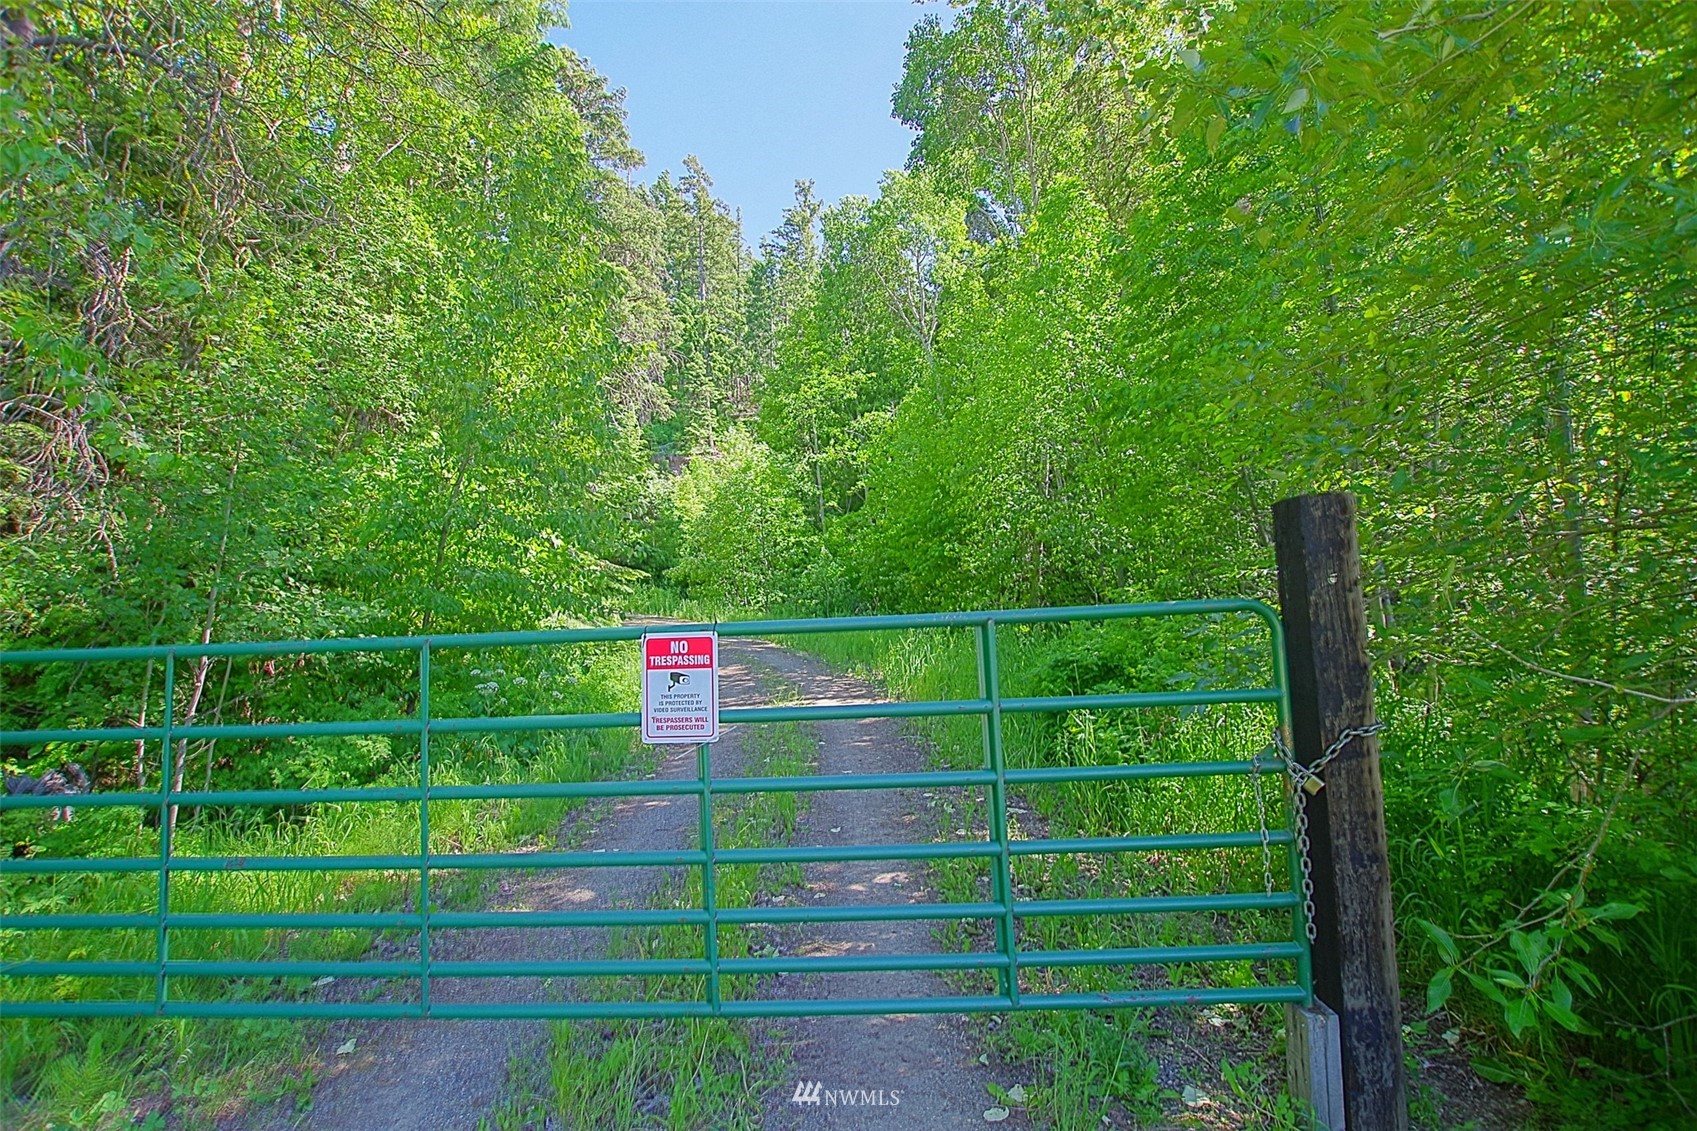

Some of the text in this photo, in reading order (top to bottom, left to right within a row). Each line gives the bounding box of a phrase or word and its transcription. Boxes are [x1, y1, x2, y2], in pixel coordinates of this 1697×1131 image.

[670, 640, 689, 654] NO
[649, 654, 710, 666] TRESPASSING
[651, 716, 693, 724] TRESPASSERS
